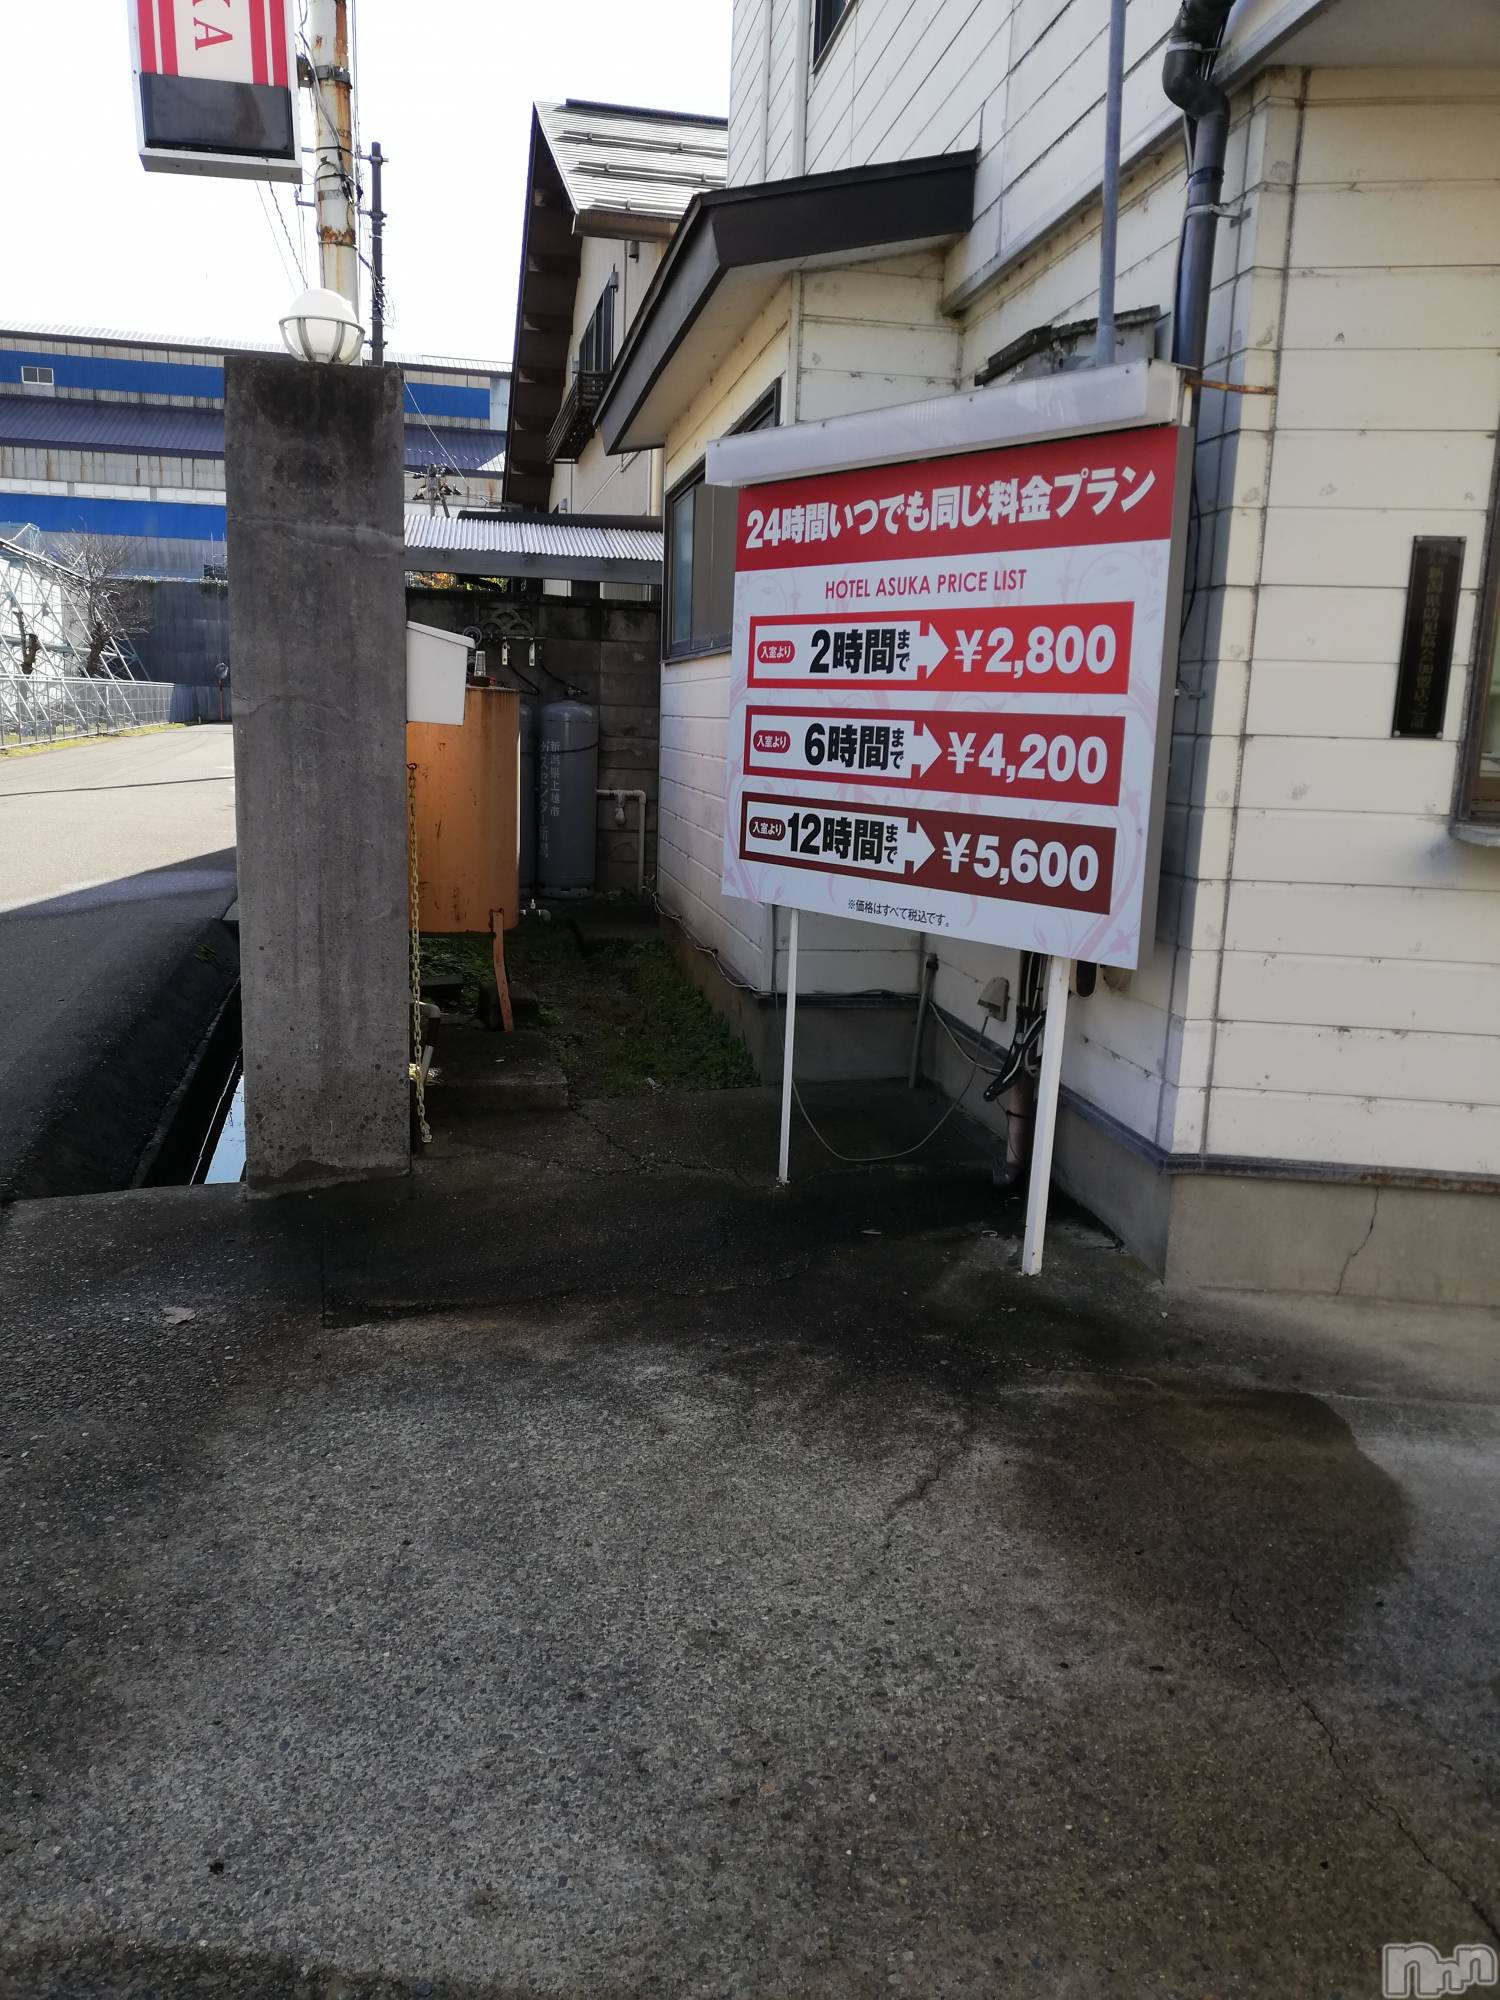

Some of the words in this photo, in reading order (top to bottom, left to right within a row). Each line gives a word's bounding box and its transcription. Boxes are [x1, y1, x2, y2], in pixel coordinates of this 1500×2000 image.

[745, 466, 1156, 549] 24時間いつでも同じ料金プラン
[825, 579, 871, 600] HOTEL
[875, 575, 931, 597] ASUKA
[937, 572, 988, 594] PRICE
[993, 569, 1027, 591] LIST
[760, 645, 791, 659] 入室より
[954, 624, 1117, 679] ¥2,800
[756, 735, 787, 749] 入室より
[947, 731, 1108, 785] ¥4,200
[752, 821, 783, 836] 入室より
[942, 831, 1099, 892] ¥5,600
